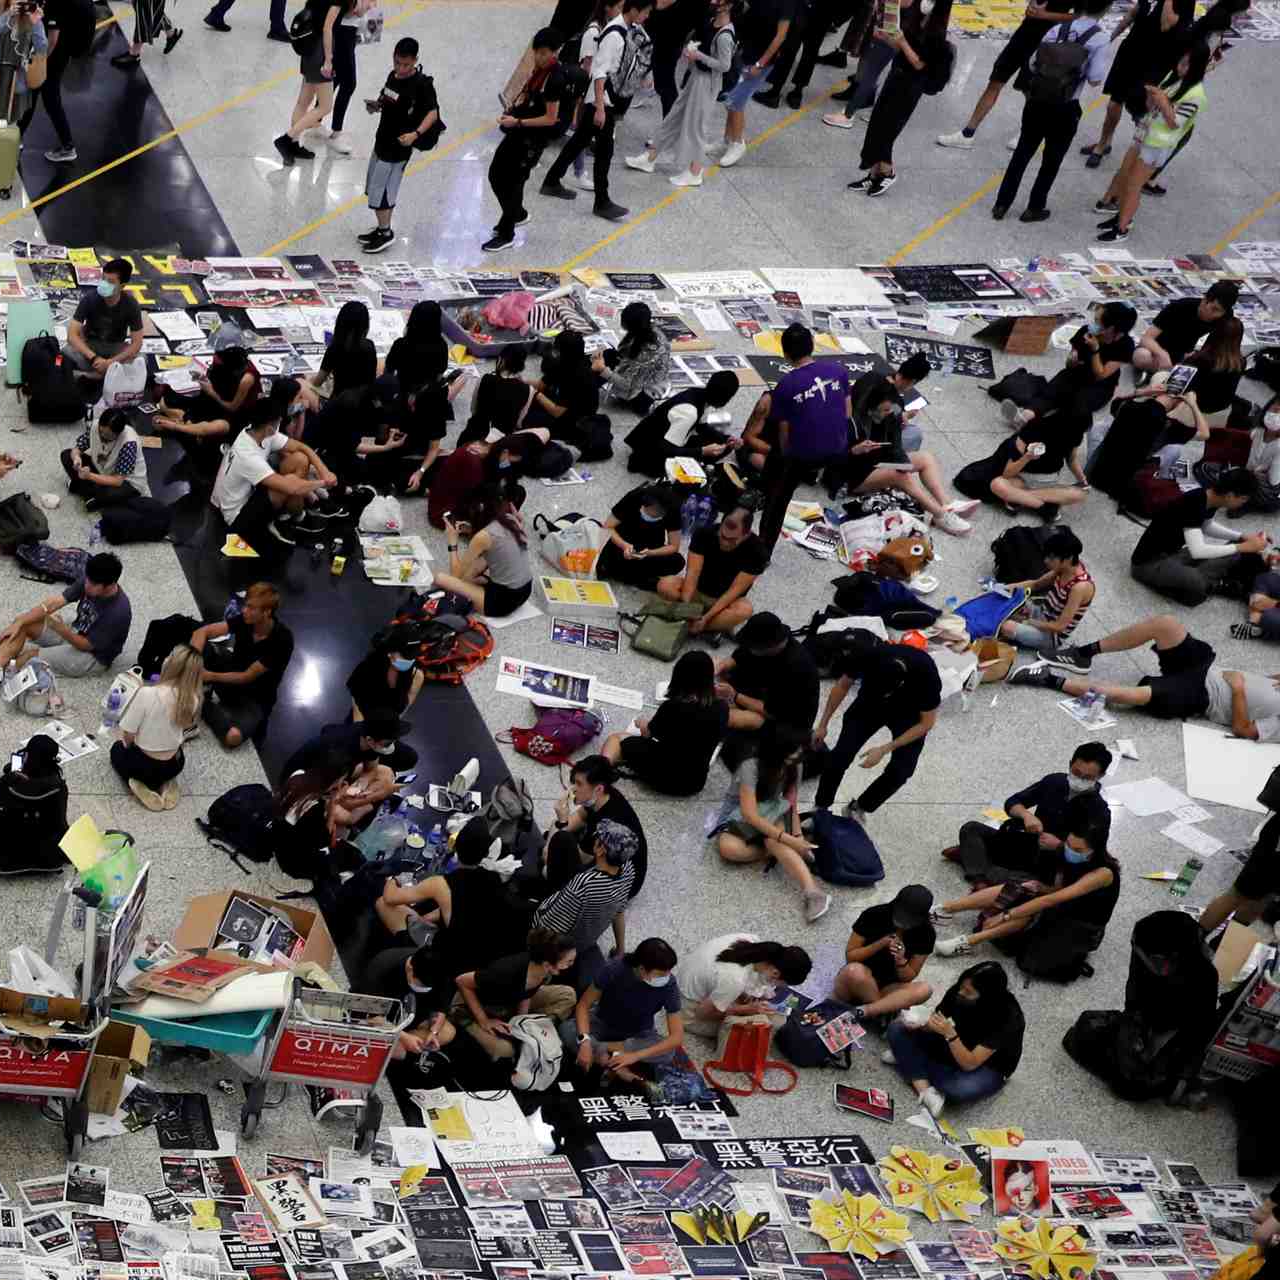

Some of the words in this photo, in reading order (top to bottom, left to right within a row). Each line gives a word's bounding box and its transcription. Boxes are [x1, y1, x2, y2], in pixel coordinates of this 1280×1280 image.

[294, 1038, 369, 1058] QIMA
[713, 1137, 861, 1168] 黑警惡行
